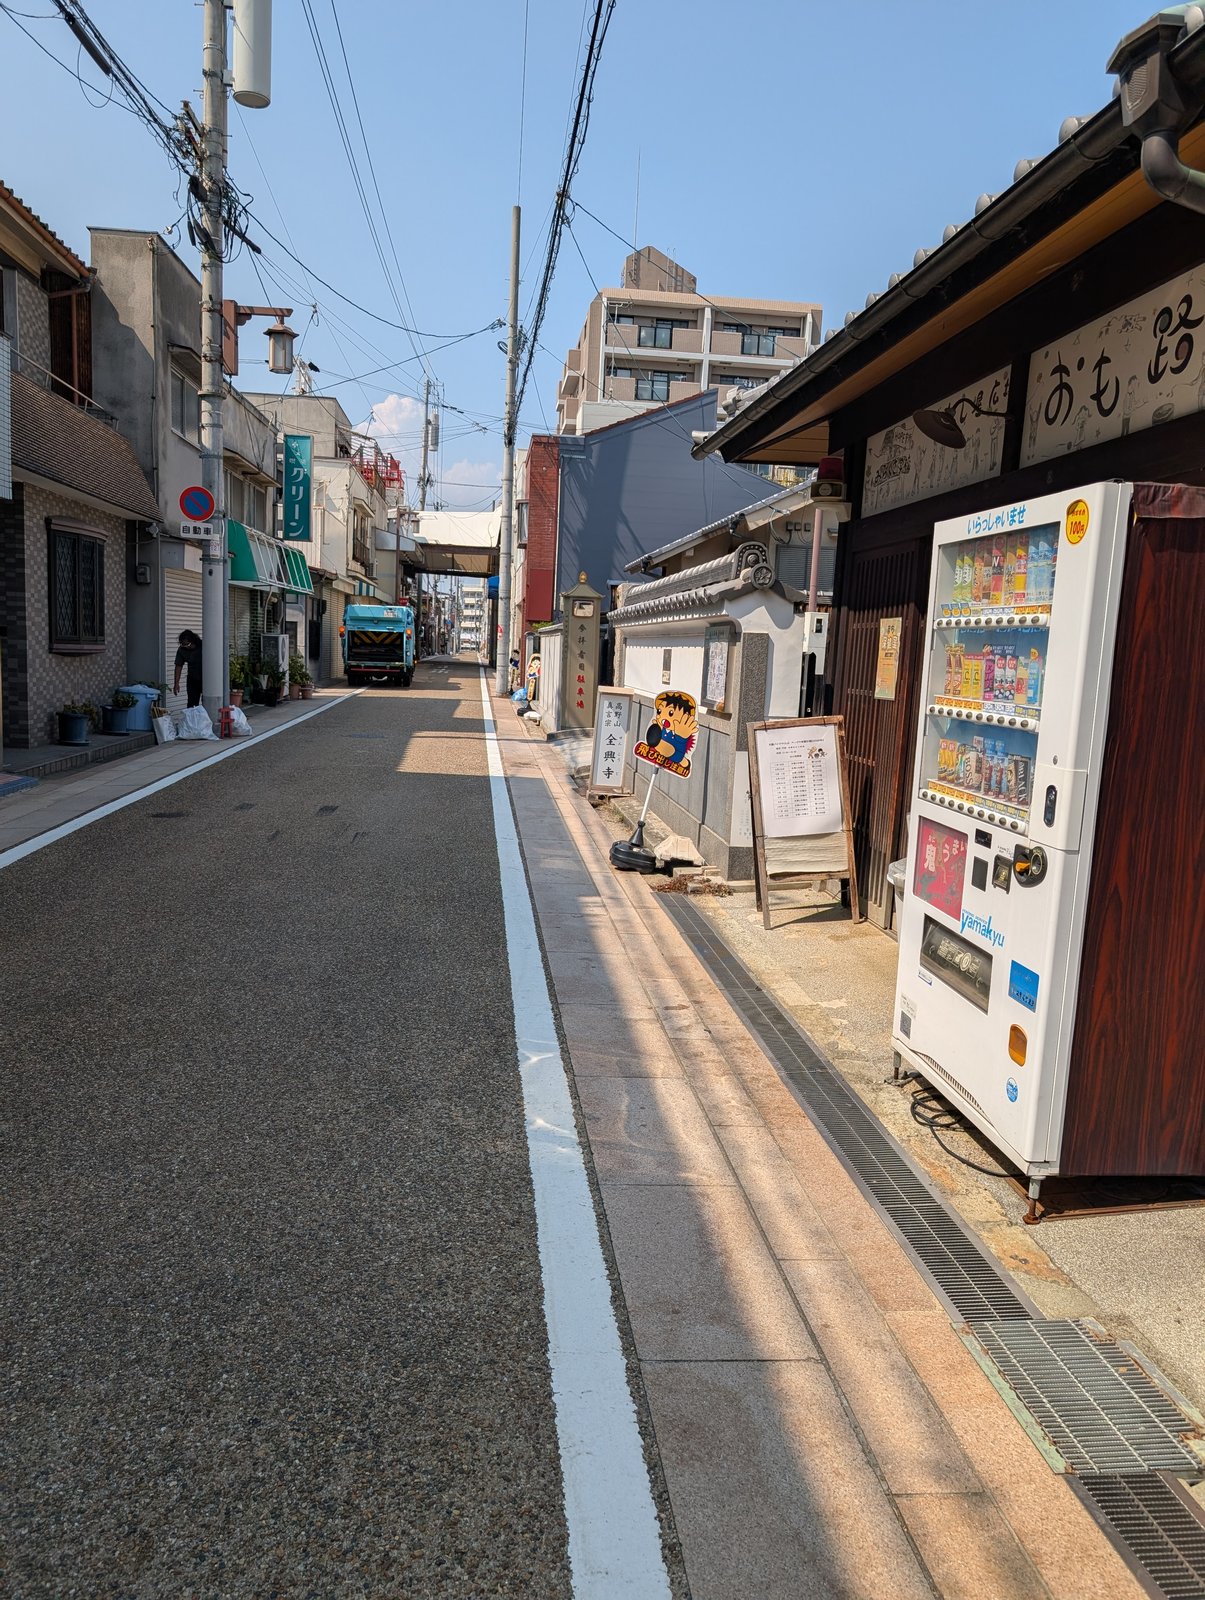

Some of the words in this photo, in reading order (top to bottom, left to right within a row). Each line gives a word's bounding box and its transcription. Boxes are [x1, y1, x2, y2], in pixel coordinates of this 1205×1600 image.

[289, 467, 307, 537] グリーン
[182, 525, 212, 536] 自動車
[967, 504, 1027, 535] いらっしゃいませ
[604, 701, 614, 728] 真言宗
[613, 702, 623, 728] 高野山
[602, 733, 617, 780] 全興寺
[965, 756, 974, 786] BOSS
[960, 912, 1005, 947] yamakyu
